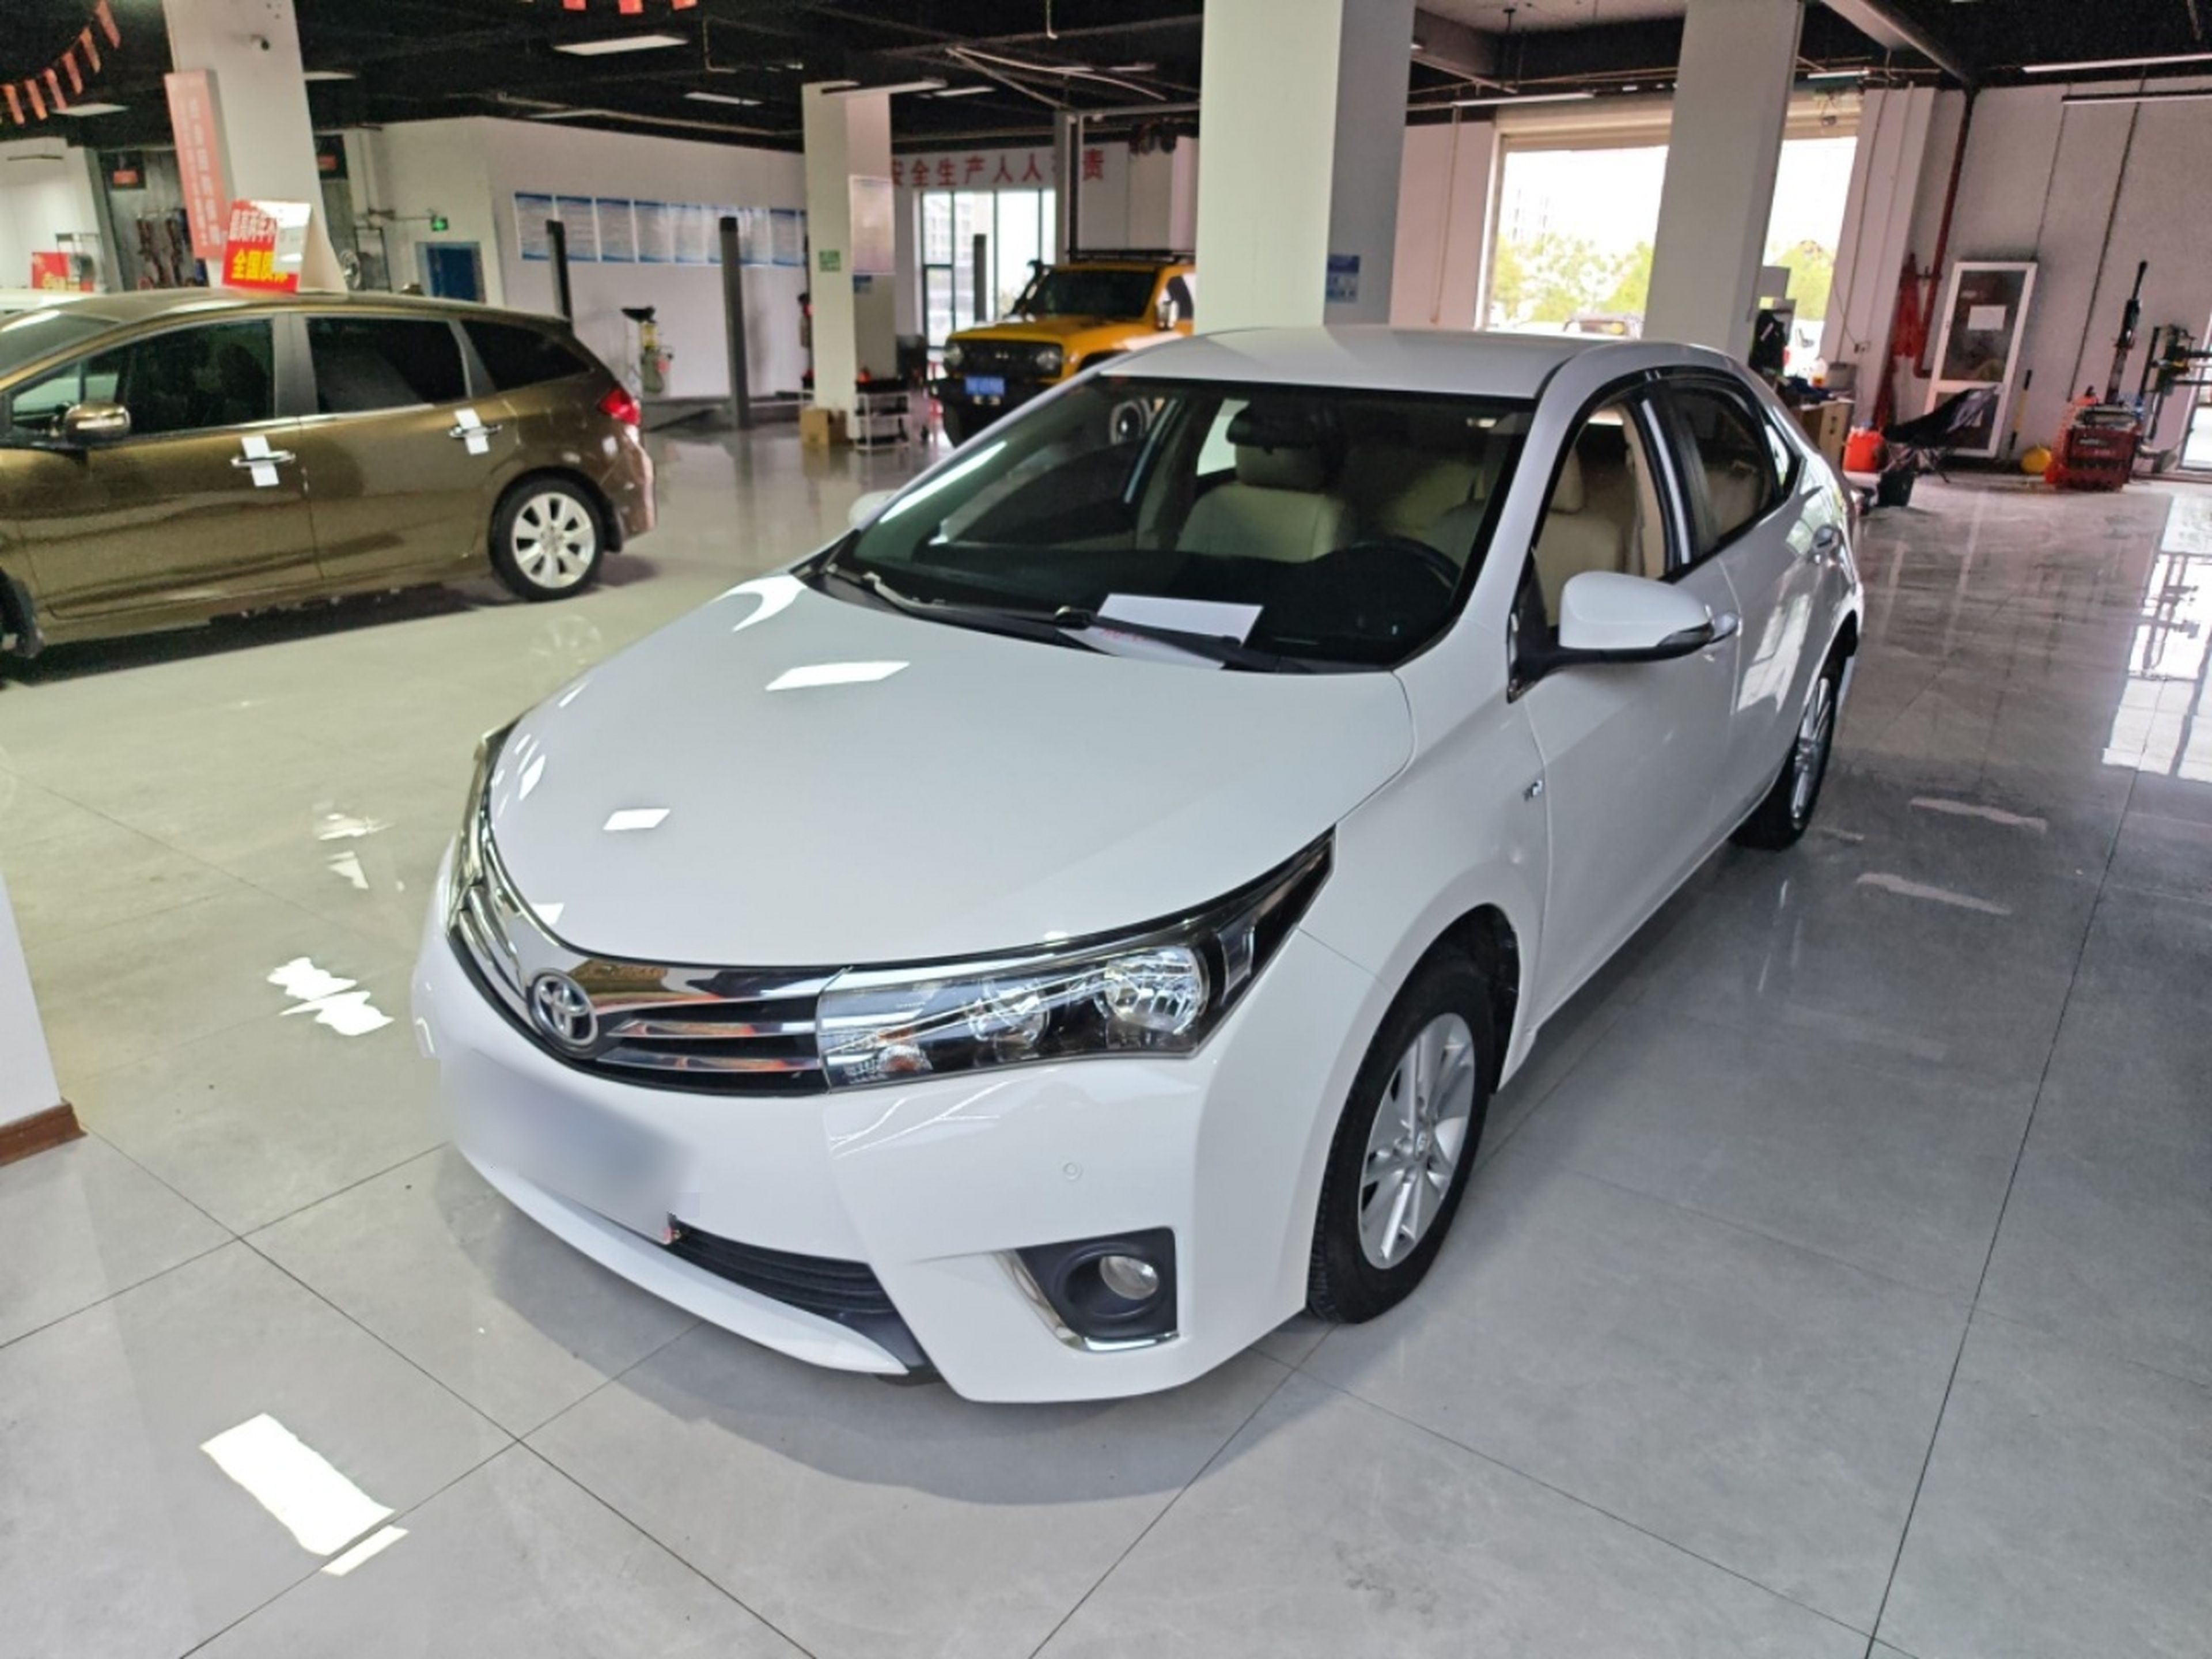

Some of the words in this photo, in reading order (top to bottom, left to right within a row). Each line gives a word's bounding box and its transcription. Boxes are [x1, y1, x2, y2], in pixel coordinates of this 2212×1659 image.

[891, 148, 1104, 187] 安全生产人人责
